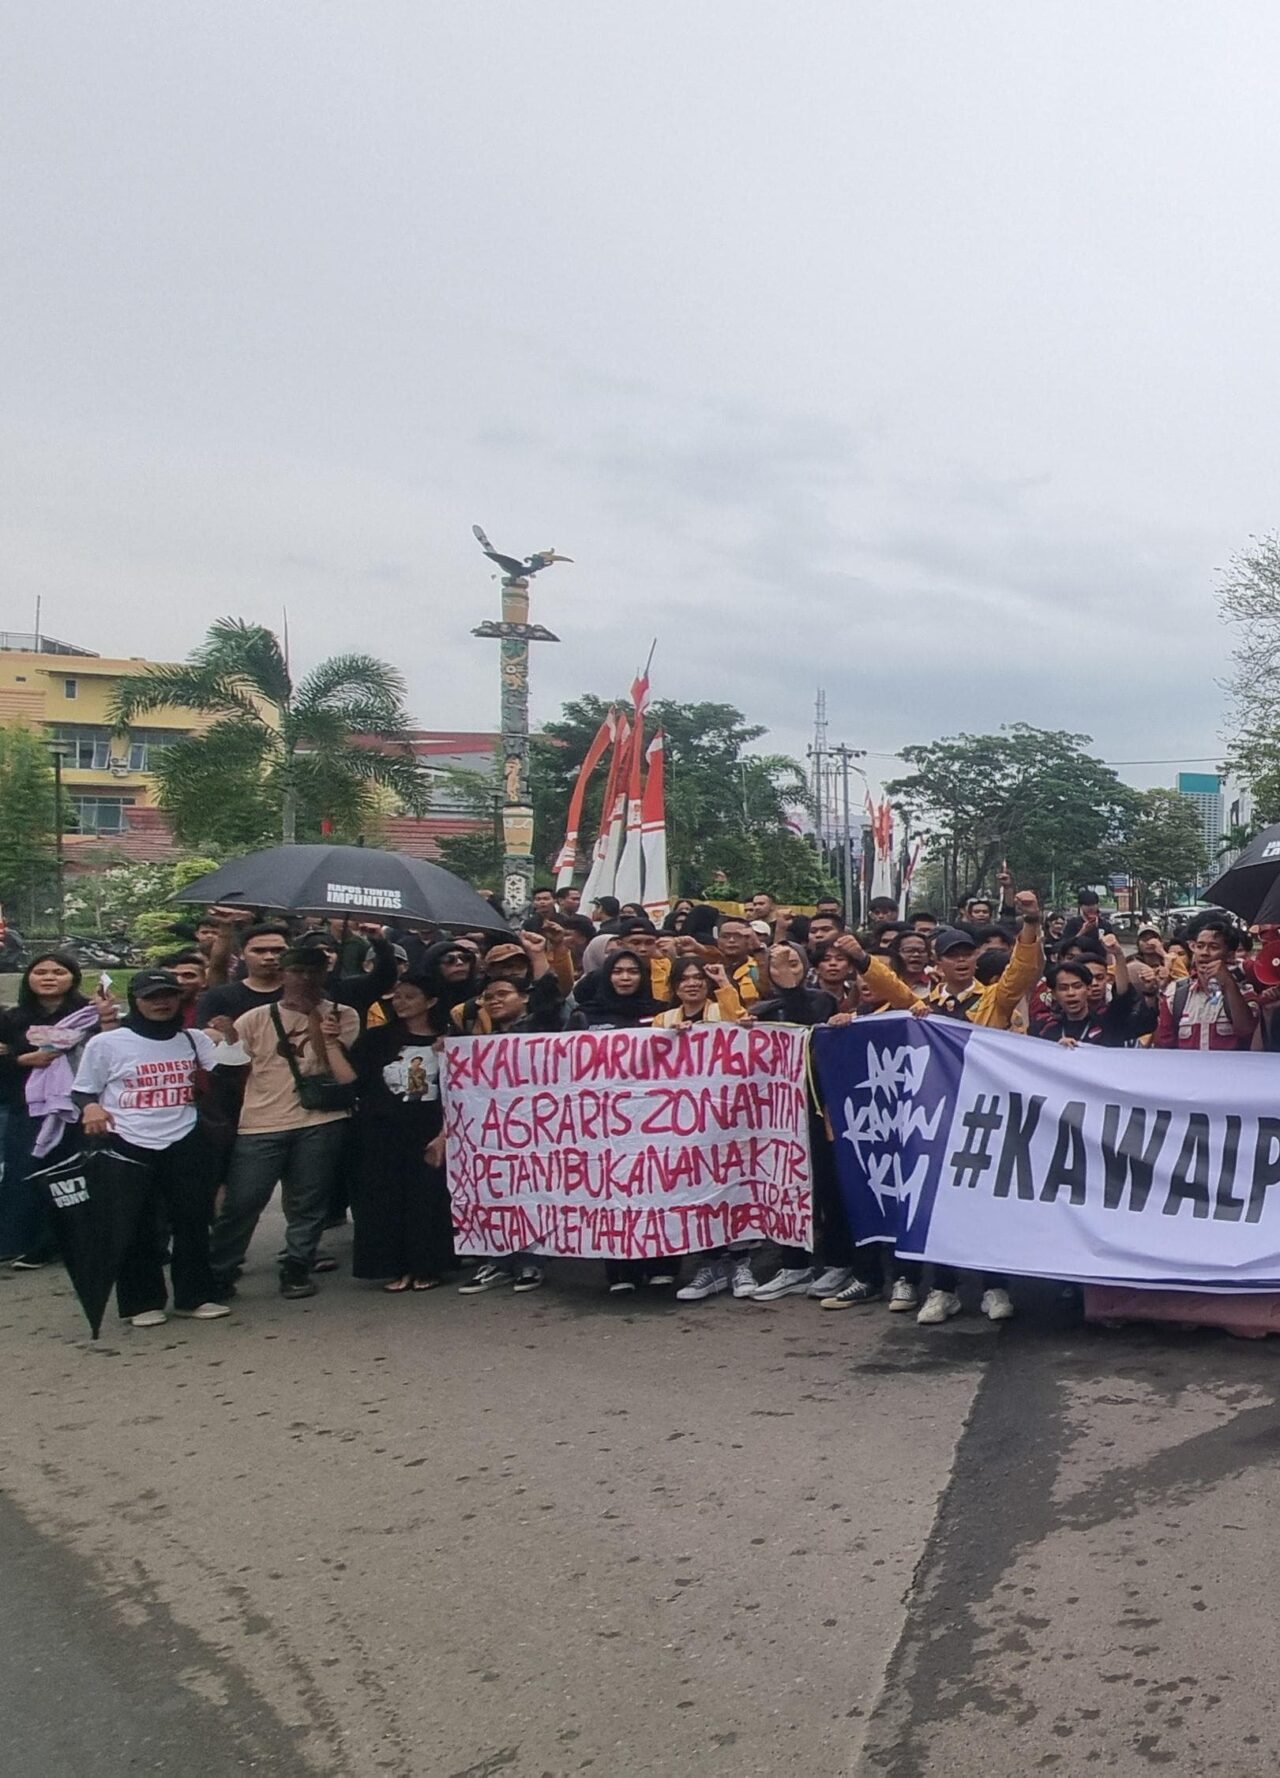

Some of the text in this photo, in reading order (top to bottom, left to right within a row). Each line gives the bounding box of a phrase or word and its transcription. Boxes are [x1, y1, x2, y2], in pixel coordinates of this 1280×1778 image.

[326, 891, 402, 909] IMPUNITAS
[122, 1072, 185, 1088] IS NOT FOR
